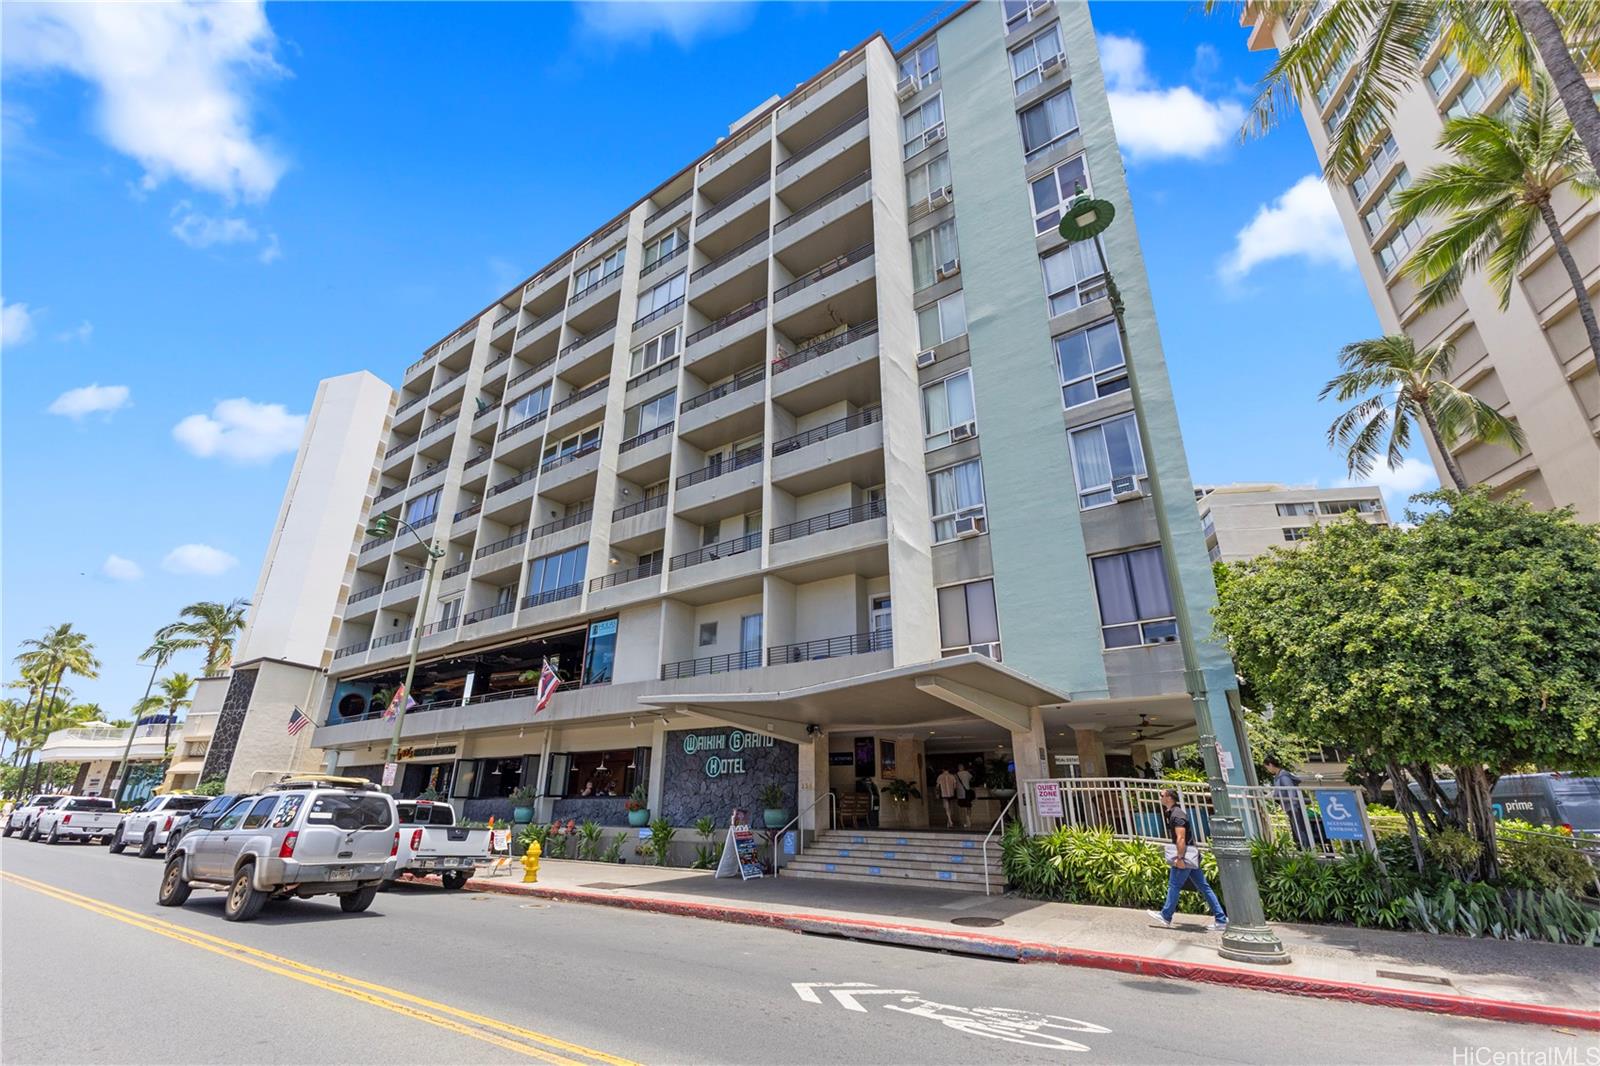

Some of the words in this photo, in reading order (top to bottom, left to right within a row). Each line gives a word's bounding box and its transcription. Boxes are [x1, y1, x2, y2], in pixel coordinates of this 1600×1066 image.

[683, 734, 726, 755] WAIKIKI
[729, 730, 774, 752] GRAND
[706, 756, 746, 777] HOTEL
[1505, 800, 1534, 813] prime
